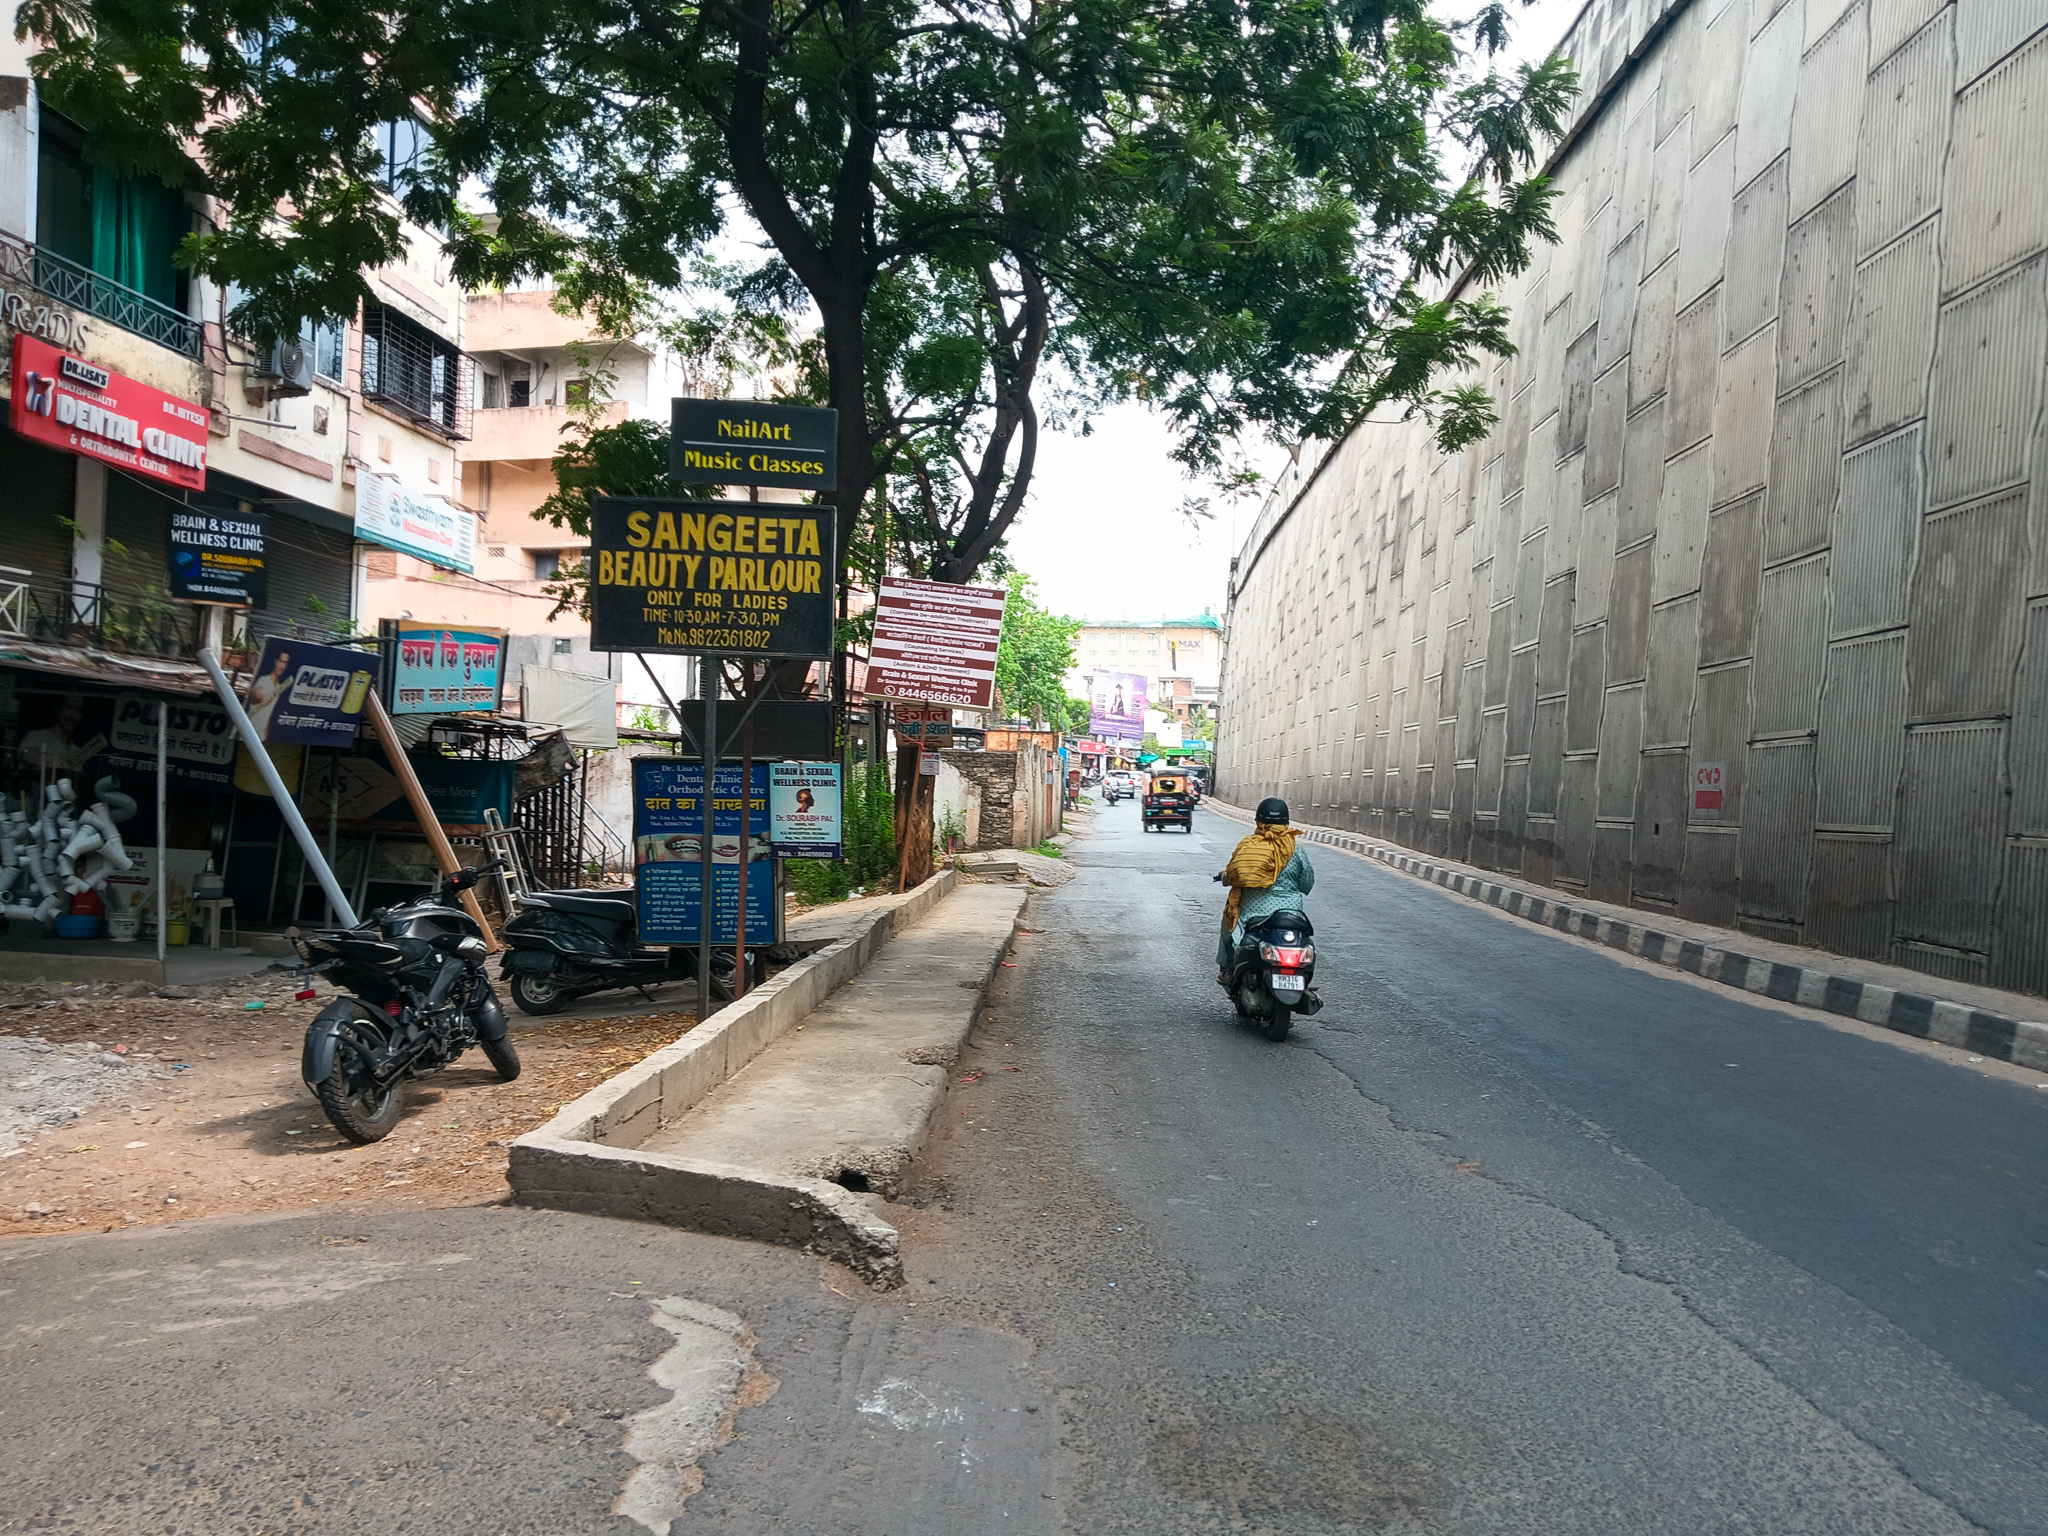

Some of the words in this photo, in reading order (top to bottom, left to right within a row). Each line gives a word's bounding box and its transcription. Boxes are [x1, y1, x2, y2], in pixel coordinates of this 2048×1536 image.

[0, 288, 90, 353] RADIS
[65, 360, 107, 385] DR.LISA'S
[57, 379, 118, 408] MULTISPECIALITY
[56, 394, 142, 448] DENTAL
[143, 428, 206, 471] CLINIC
[70, 434, 78, 445] &
[81, 436, 137, 466] ORTHODONTIC
[140, 456, 169, 476] CENTRE
[684, 450, 743, 471] Music
[749, 454, 825, 475] Classes
[173, 513, 206, 530] BRAIN
[209, 518, 219, 532] &
[221, 520, 261, 536] SEXUAL
[625, 510, 821, 556] SANGEETA
[171, 529, 227, 548] WELLNESS
[229, 536, 264, 552] CLINIC
[599, 549, 703, 589] BEAUTY
[709, 556, 821, 594] PARLOUR
[647, 590, 684, 606] ONLY
[694, 592, 722, 608] FOR
[733, 594, 788, 610] LADIES
[890, 609, 919, 619] (Complete
[919, 612, 956, 622] De-addiction
[957, 617, 988, 626] Treatment)
[938, 648, 964, 656] Services)
[1178, 640, 1201, 648] MAX
[463, 642, 498, 682] दुकान
[893, 660, 916, 669] (Autism
[938, 666, 970, 676] Treatment)
[297, 671, 346, 691] PLASTO
[882, 669, 901, 679] Brain
[901, 671, 907, 679] &
[908, 672, 930, 682] Sexual
[931, 675, 961, 685] Wellness
[960, 678, 978, 688] Clinic
[898, 687, 972, 705] 8446566620
[676, 765, 700, 773] Lisa's
[677, 775, 704, 783] Denta
[713, 774, 743, 783] Clinic
[774, 768, 798, 776] BRAIN
[805, 768, 833, 776] SEXUAL
[319, 775, 349, 793] AS
[424, 785, 446, 796] See
[450, 786, 478, 798] More
[668, 785, 728, 794] Orthodtic
[731, 785, 765, 794] Cetre
[772, 779, 811, 787] WELLNESS
[811, 779, 837, 787] CLINIC
[644, 793, 672, 811] दांत
[675, 797, 697, 811] का
[700, 797, 766, 811] वाखना
